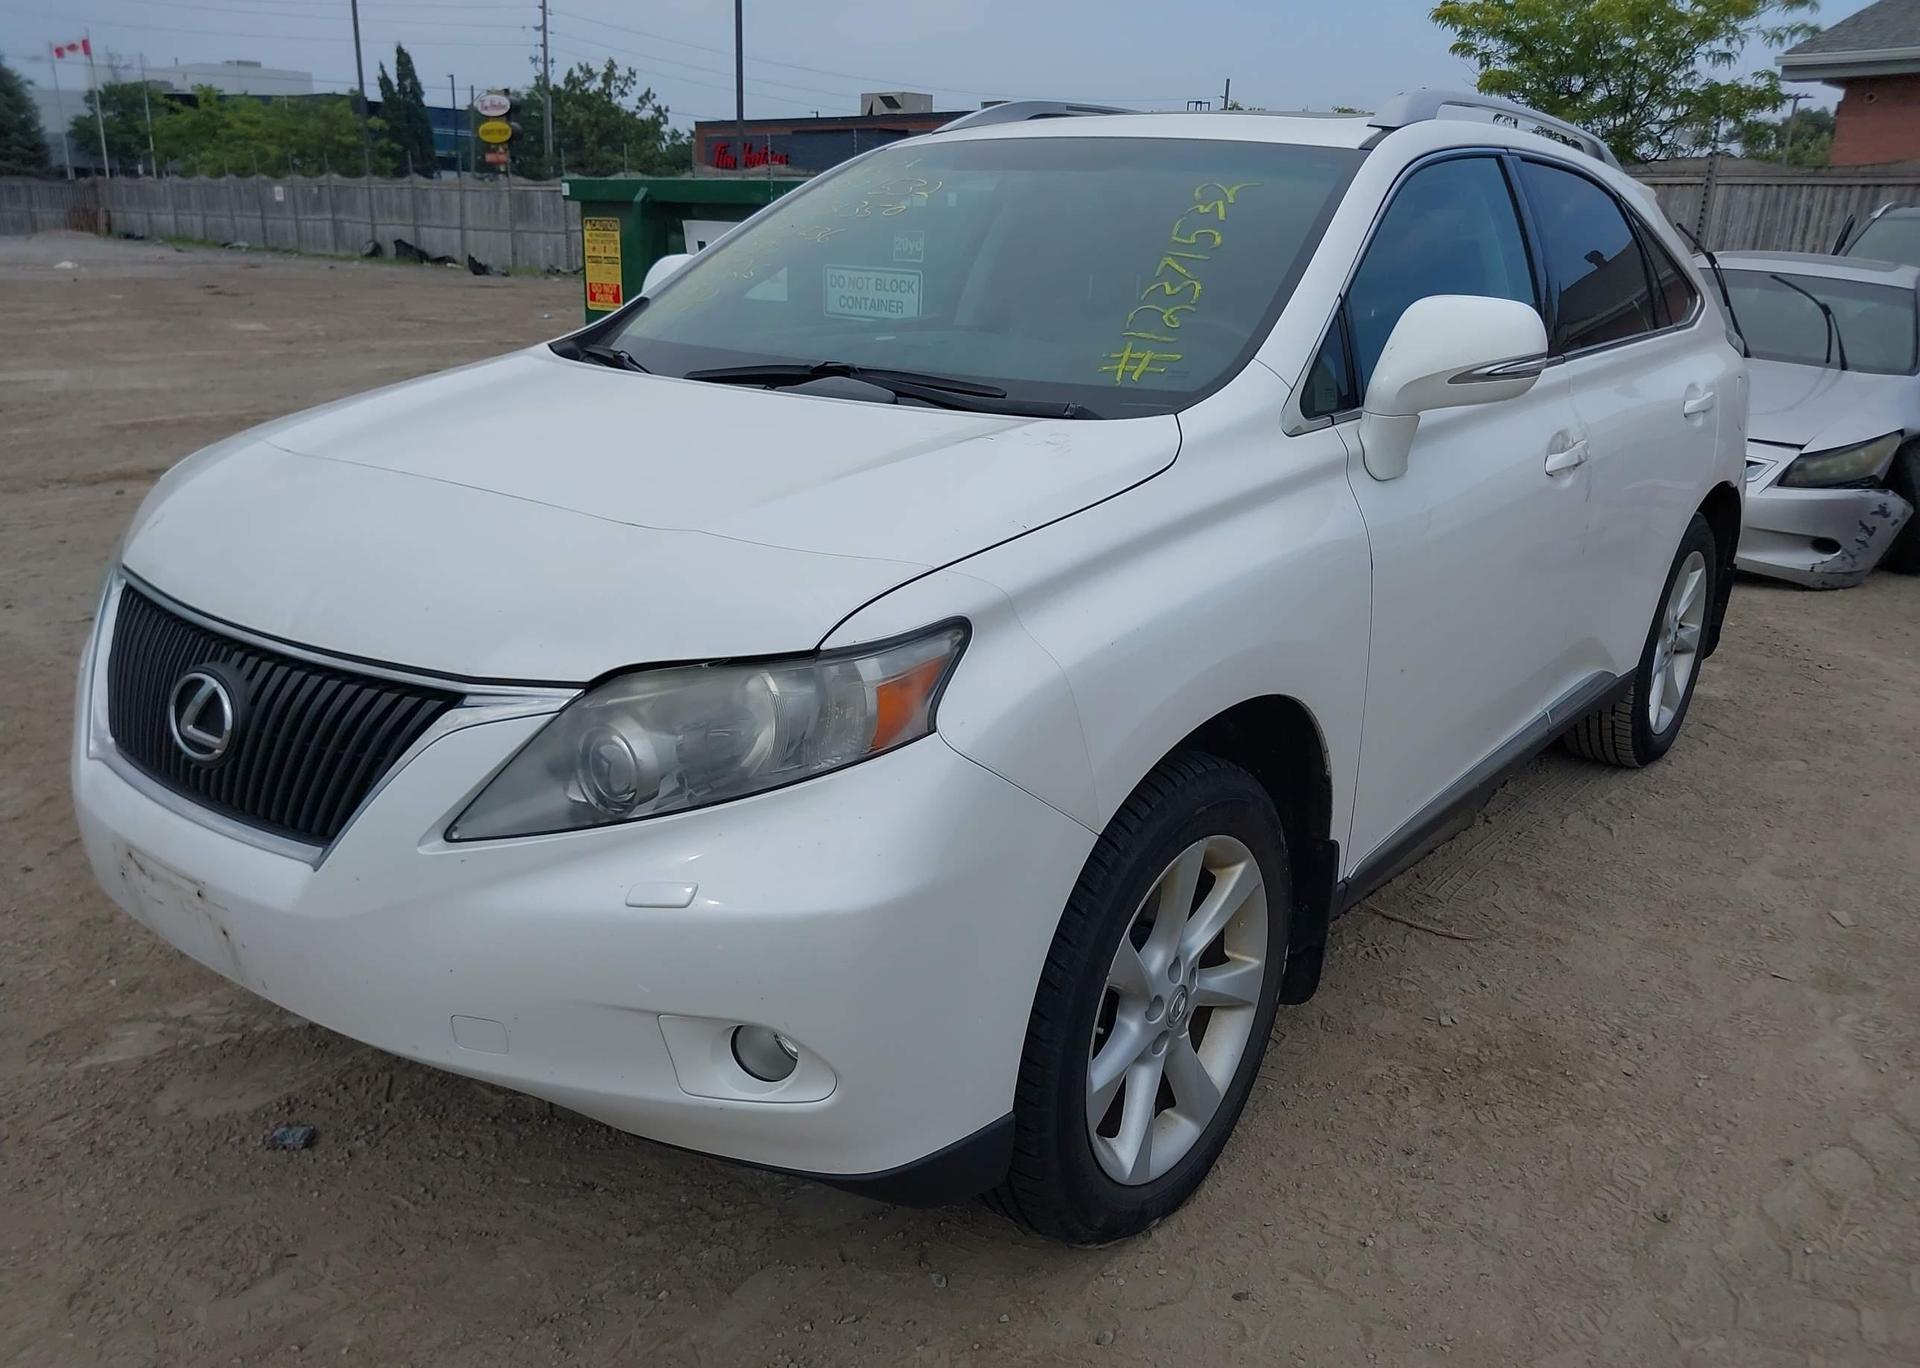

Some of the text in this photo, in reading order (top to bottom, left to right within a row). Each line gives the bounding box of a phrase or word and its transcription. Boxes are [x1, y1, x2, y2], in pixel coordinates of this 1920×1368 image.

[715, 143, 737, 169] Tim
[896, 238, 922, 255] 20yd
[830, 274, 915, 294] DO NOT BLOCK
[839, 295, 904, 314] CONTAINER
